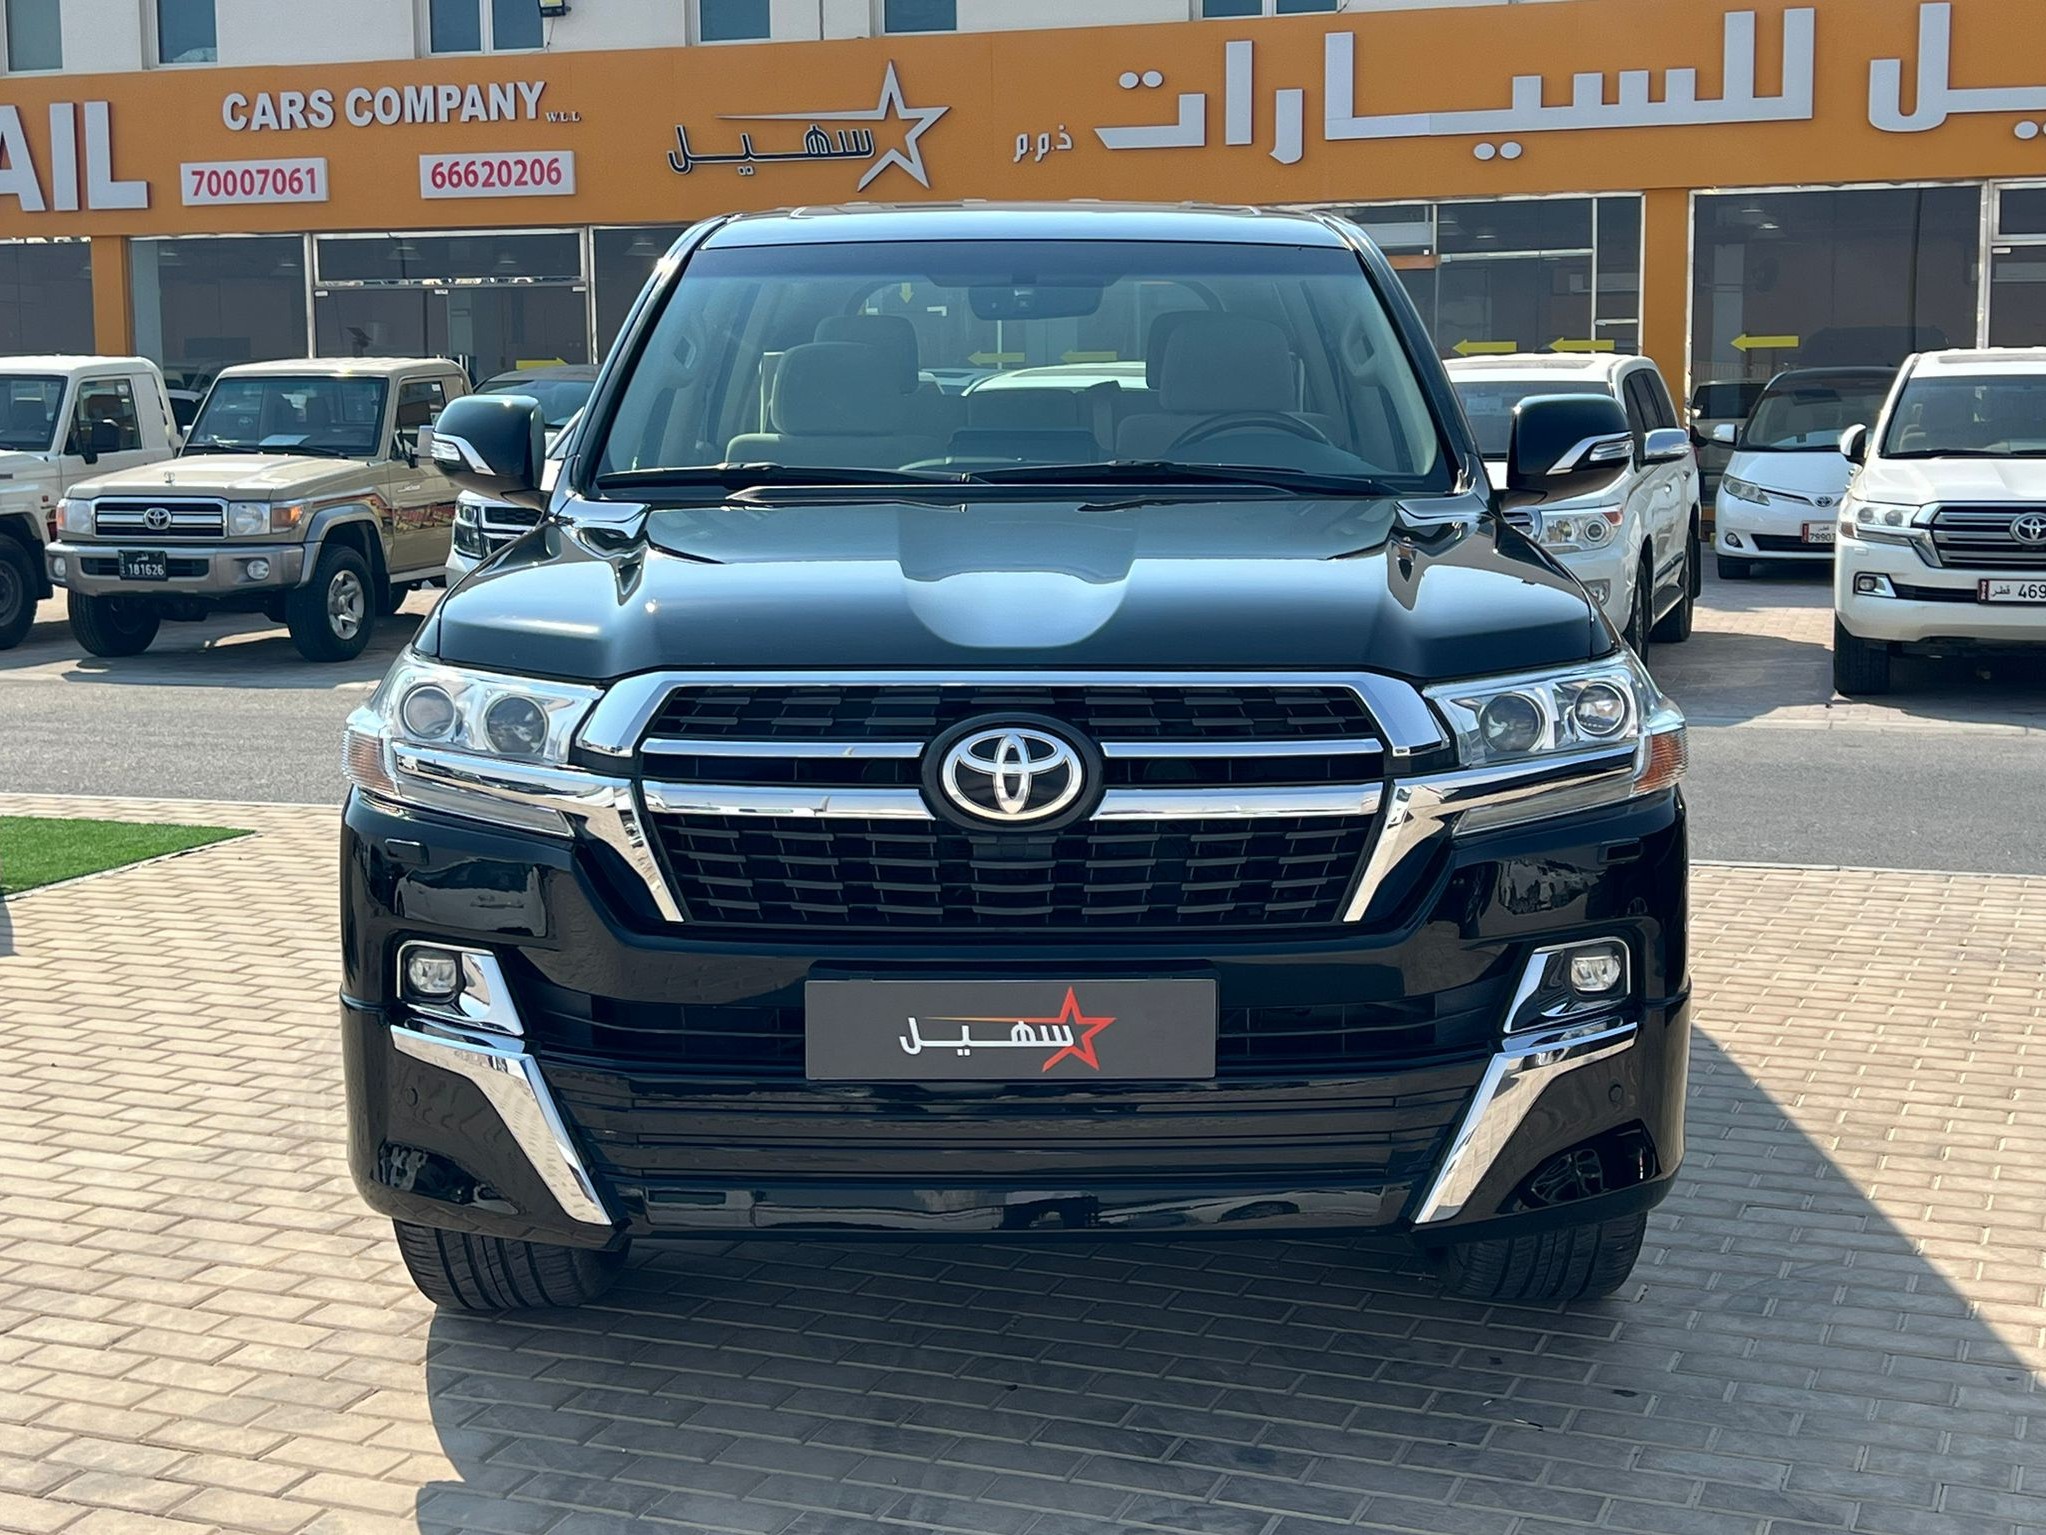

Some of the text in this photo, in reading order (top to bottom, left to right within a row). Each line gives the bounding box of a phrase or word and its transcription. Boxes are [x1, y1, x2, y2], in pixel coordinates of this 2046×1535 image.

[1094, 8, 1816, 165] للسيارات
[222, 89, 335, 131] CARS
[344, 80, 546, 127] COMPANY
[668, 123, 876, 177] سهيل
[190, 167, 318, 197] 70007061
[430, 157, 563, 190] 66620206
[128, 563, 165, 576] 181626
[2018, 583, 2046, 599] 469
[899, 1016, 1075, 1057] سهيل
